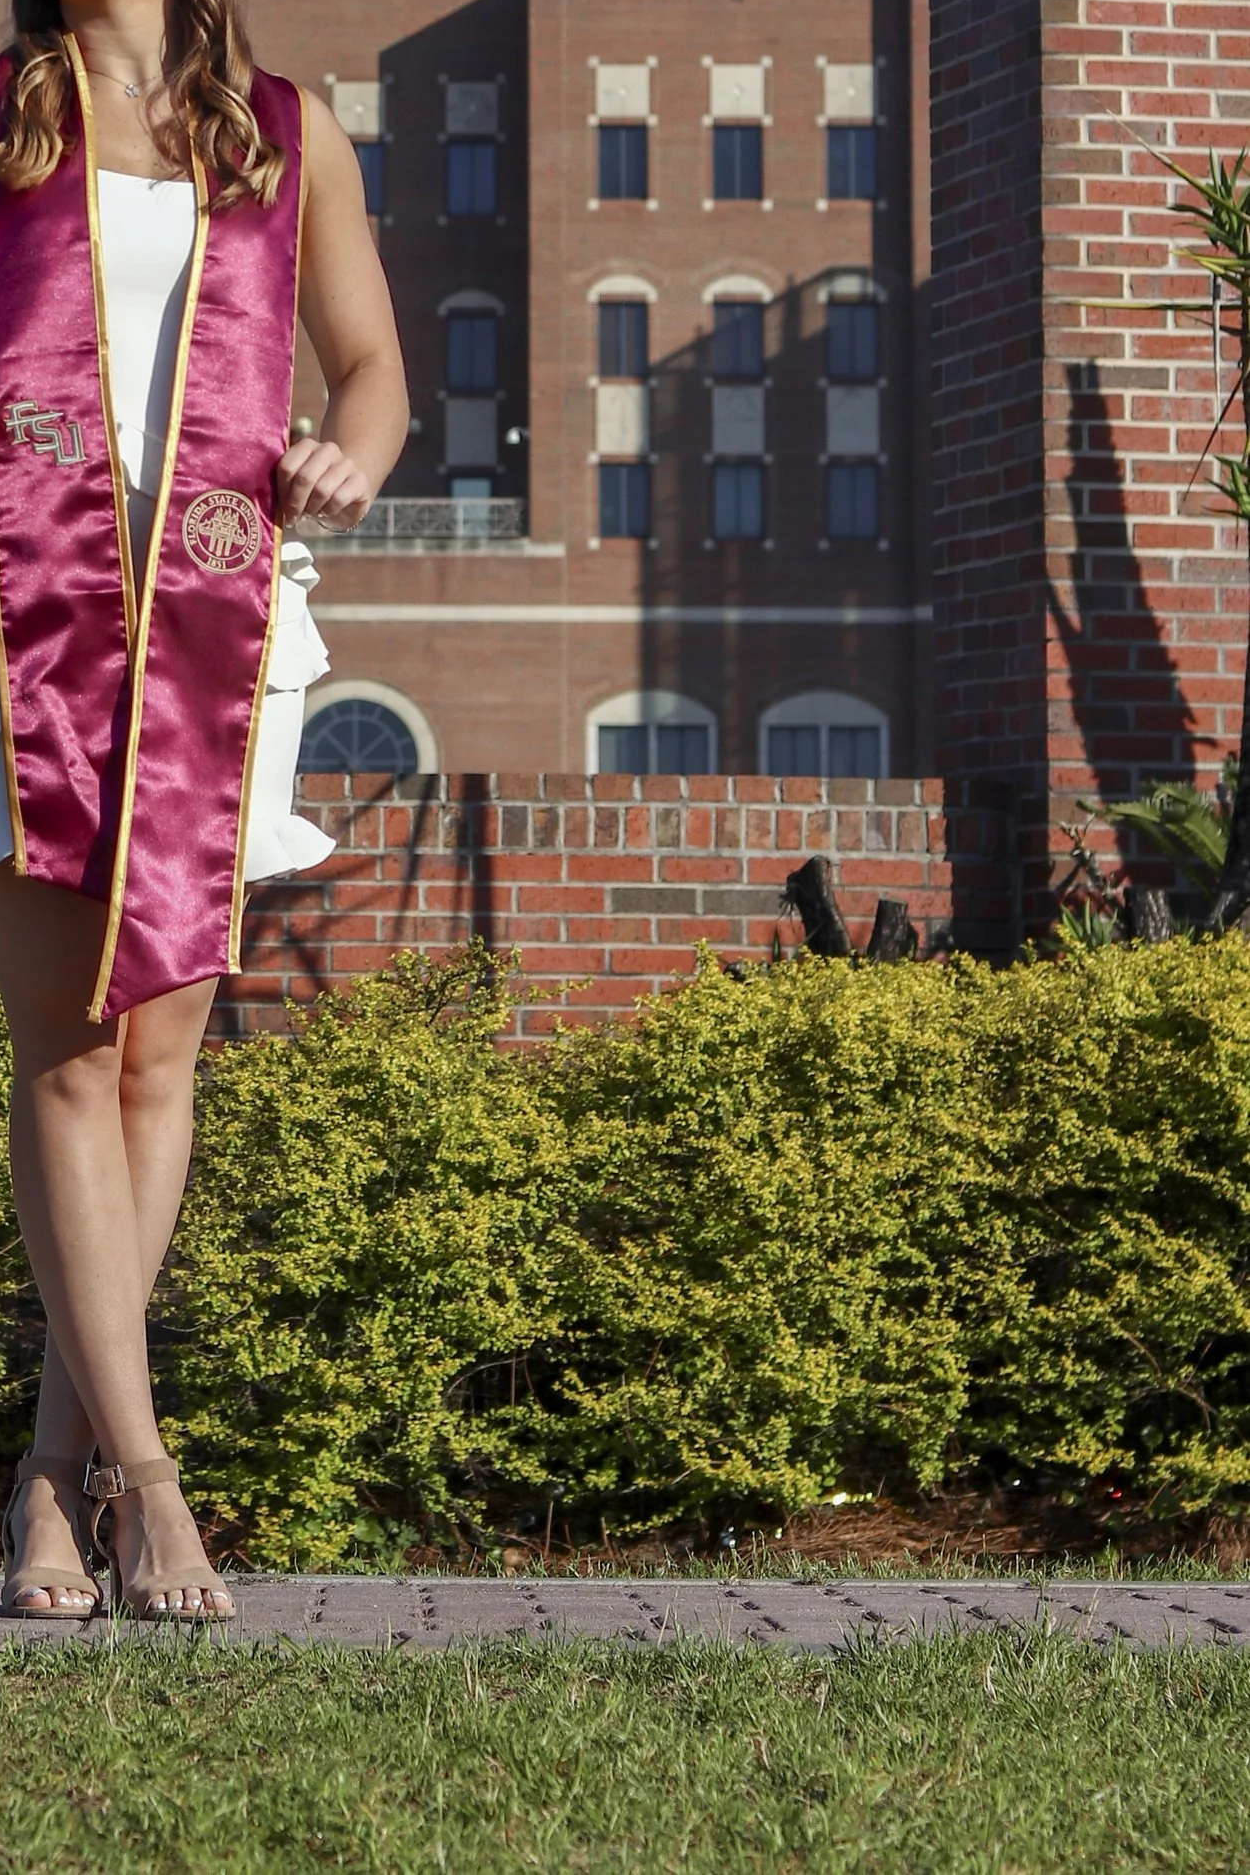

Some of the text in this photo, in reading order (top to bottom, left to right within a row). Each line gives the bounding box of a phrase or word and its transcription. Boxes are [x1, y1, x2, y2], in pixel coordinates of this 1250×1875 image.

[3, 400, 87, 466] FSU
[188, 495, 258, 562] FLORIDA STATE UNIVERSITY
[207, 556, 227, 570] 1851
